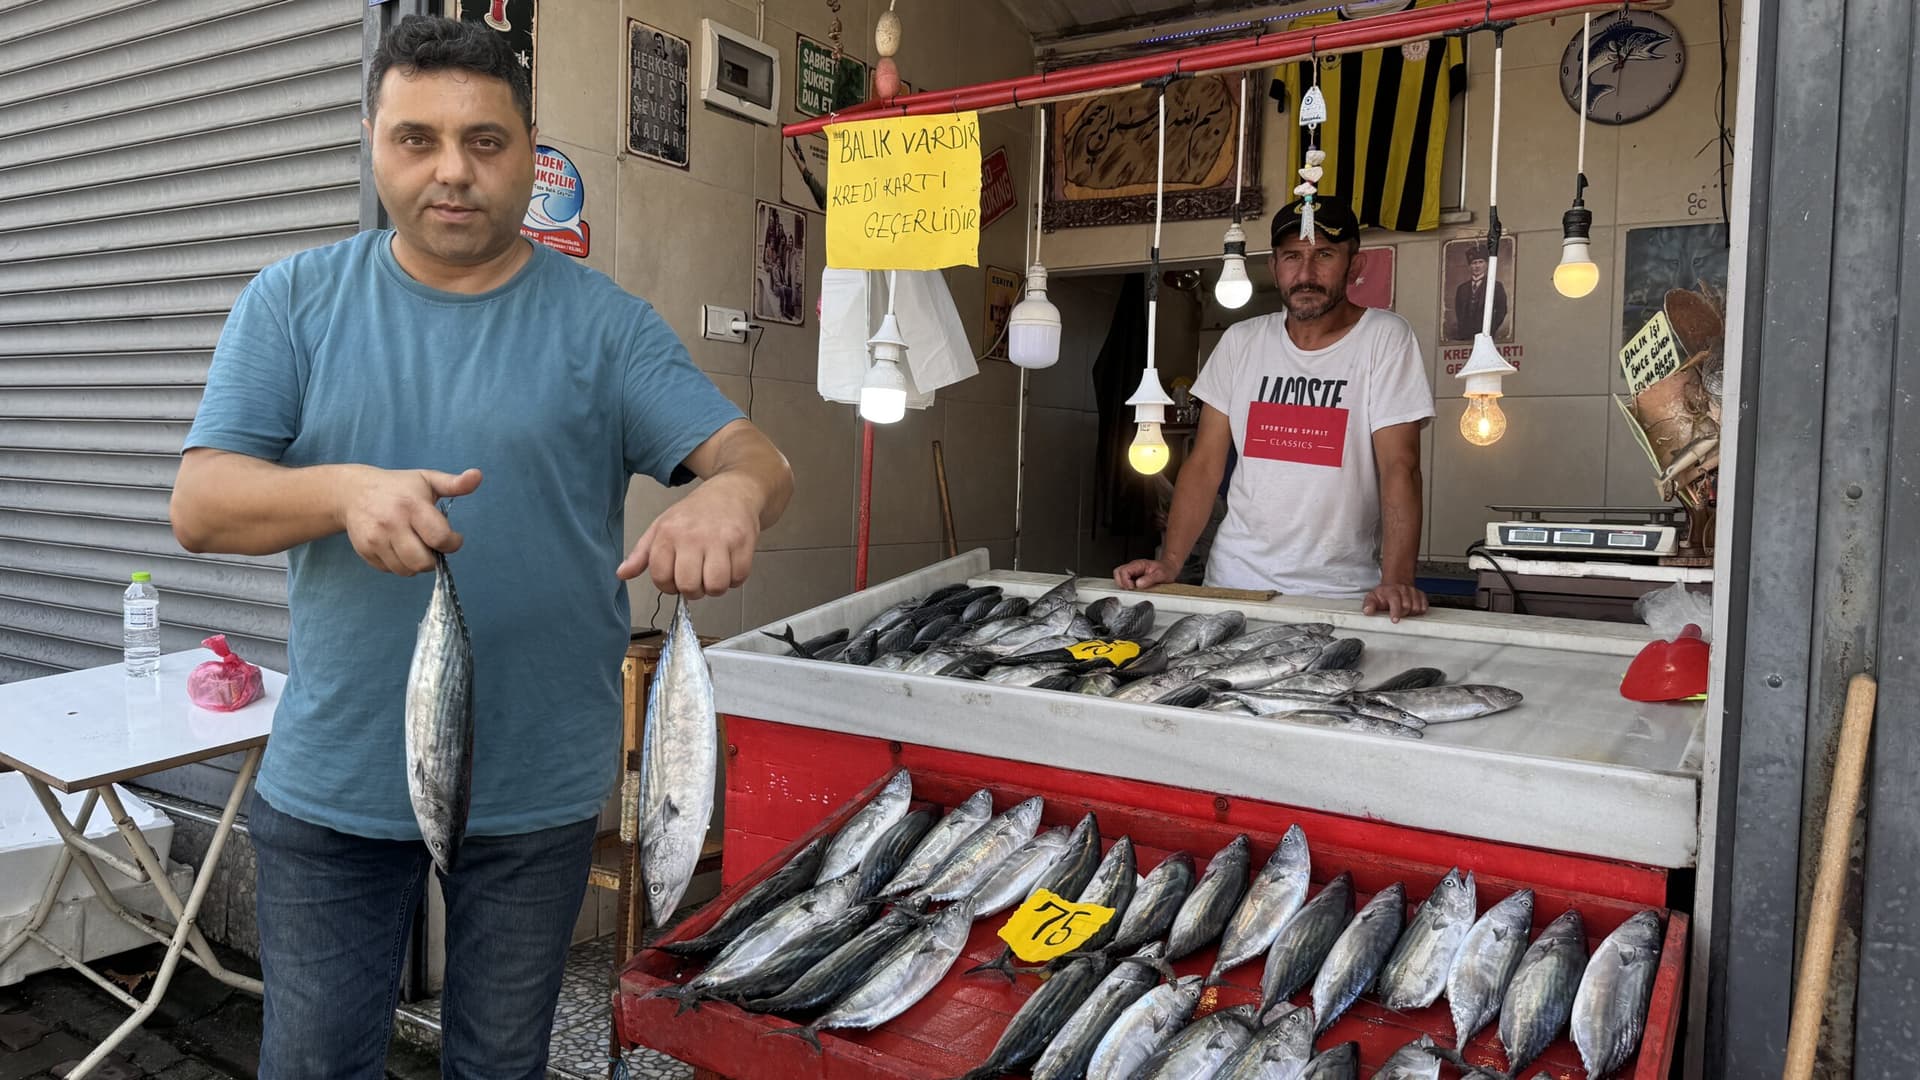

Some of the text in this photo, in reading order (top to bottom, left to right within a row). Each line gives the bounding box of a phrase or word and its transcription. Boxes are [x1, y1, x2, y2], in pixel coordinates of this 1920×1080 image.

[633, 49, 686, 83] HERKESİN
[802, 48, 836, 75] SABRET
[1562, 66, 1569, 77] 9
[1674, 52, 1682, 64] 3
[632, 67, 686, 105] ACISI
[802, 66, 834, 95] ŞÜKRET
[632, 95, 686, 128] SEVGİSİ
[802, 88, 833, 113] DUA ET
[1615, 112, 1622, 122] 6
[840, 129, 892, 163] BALIK
[901, 121, 980, 154] VARDIR
[535, 154, 563, 171] LDEN
[535, 168, 576, 190] IKÇILIK
[832, 171, 946, 207] KREDİ KARTI
[864, 204, 977, 243] GEÇERLİDİR
[1443, 347, 1473, 360] KRE
[1624, 319, 1661, 368] BALIK İŞİ
[1631, 334, 1671, 379] ÖNCE GÜVEN
[1257, 375, 1348, 409] LACOSTE
[1260, 424, 1329, 436] SPORTING SPIRIT
[1269, 438, 1313, 449] CLASSICS
[1034, 901, 1092, 945] 75
